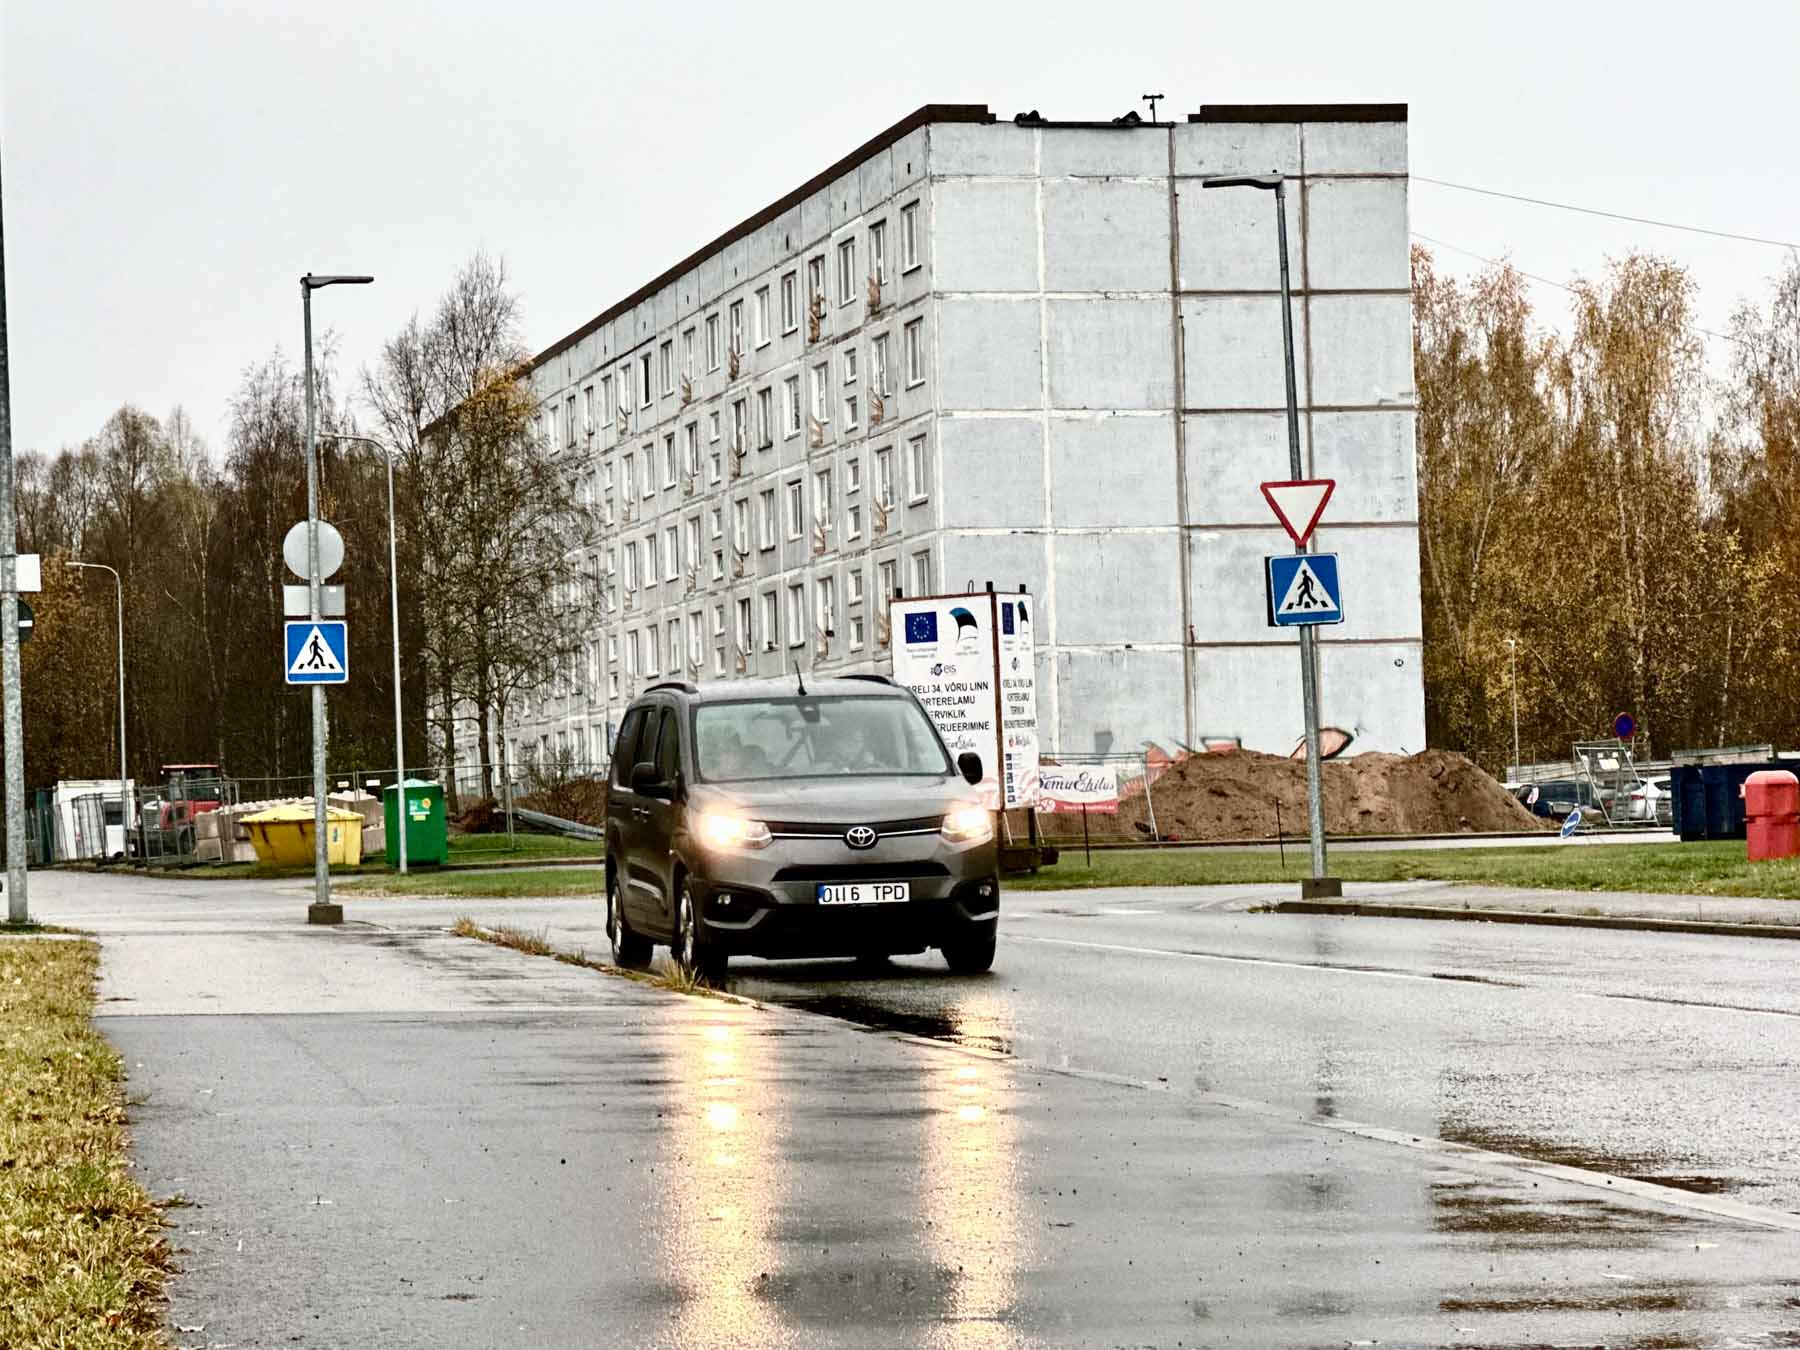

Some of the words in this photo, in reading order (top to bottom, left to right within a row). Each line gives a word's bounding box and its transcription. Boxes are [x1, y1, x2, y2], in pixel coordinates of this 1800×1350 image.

[945, 681, 968, 692] VÕRU
[970, 681, 989, 691] LINN
[873, 885, 905, 901] TPD
